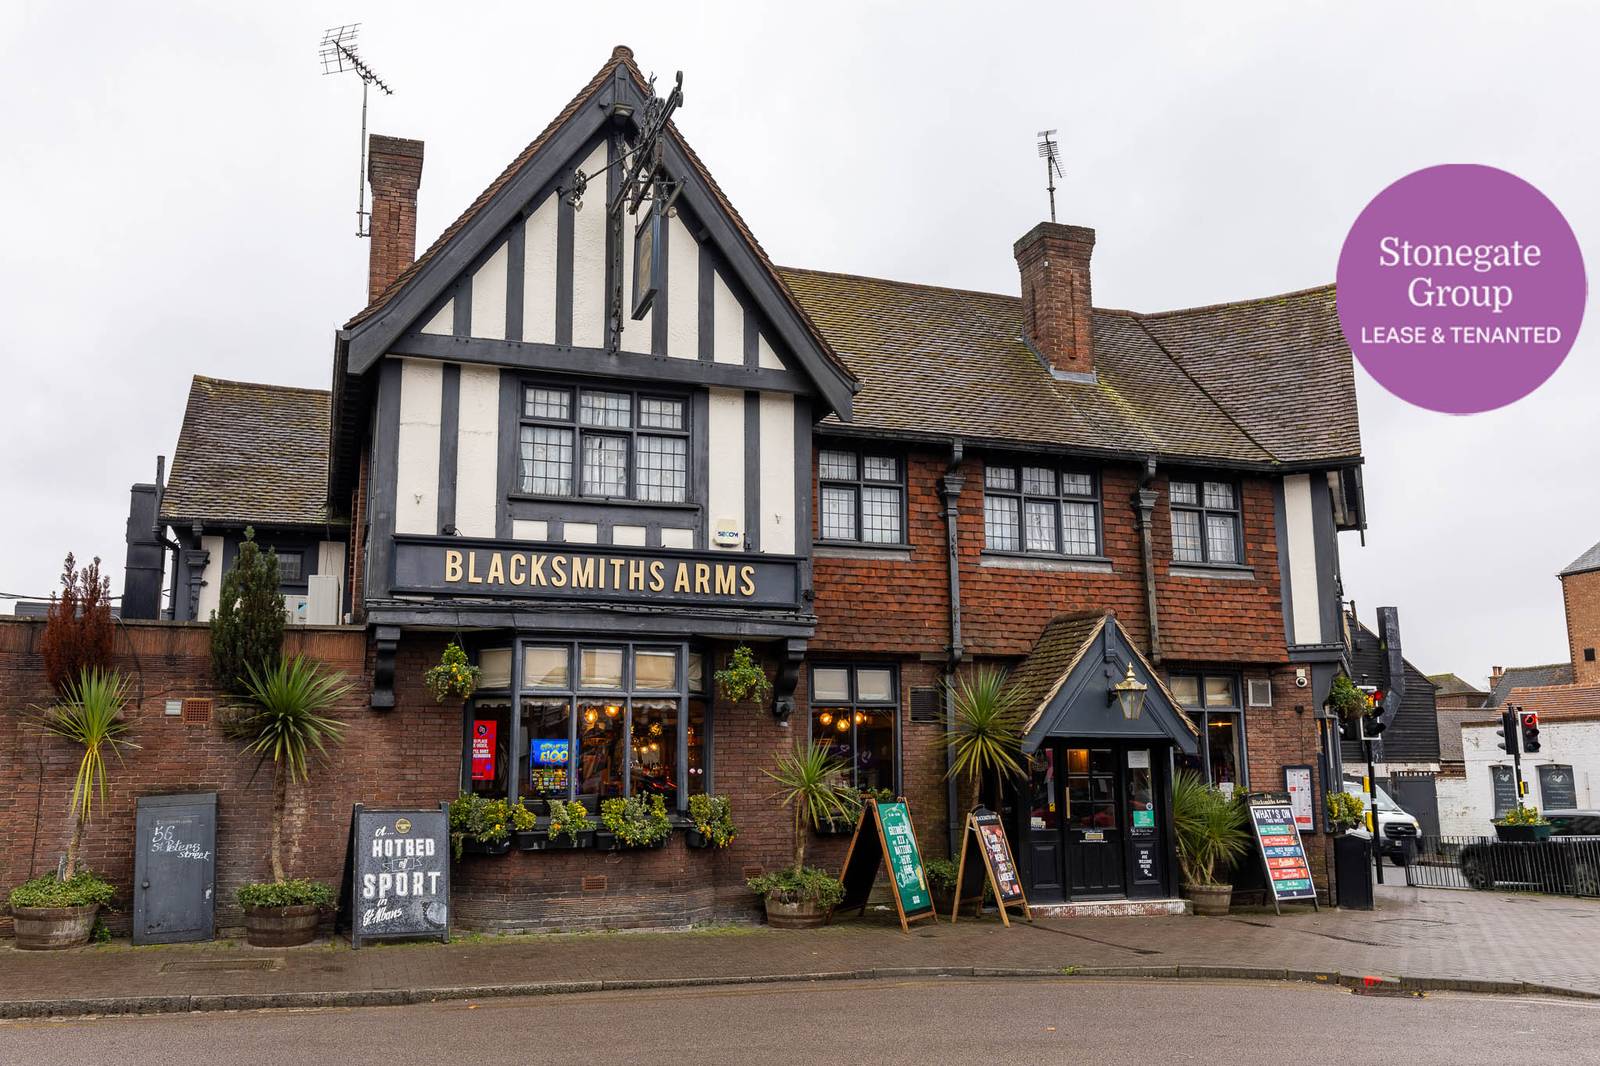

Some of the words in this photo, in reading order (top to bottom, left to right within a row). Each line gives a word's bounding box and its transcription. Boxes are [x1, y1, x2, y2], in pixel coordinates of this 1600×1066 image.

[444, 550, 666, 592] BLACKSMITHS
[673, 562, 757, 596] ARMS
[1254, 809, 1280, 819] WHAT'S
[372, 838, 436, 857] HOTBED
[363, 871, 441, 900] SPORT
